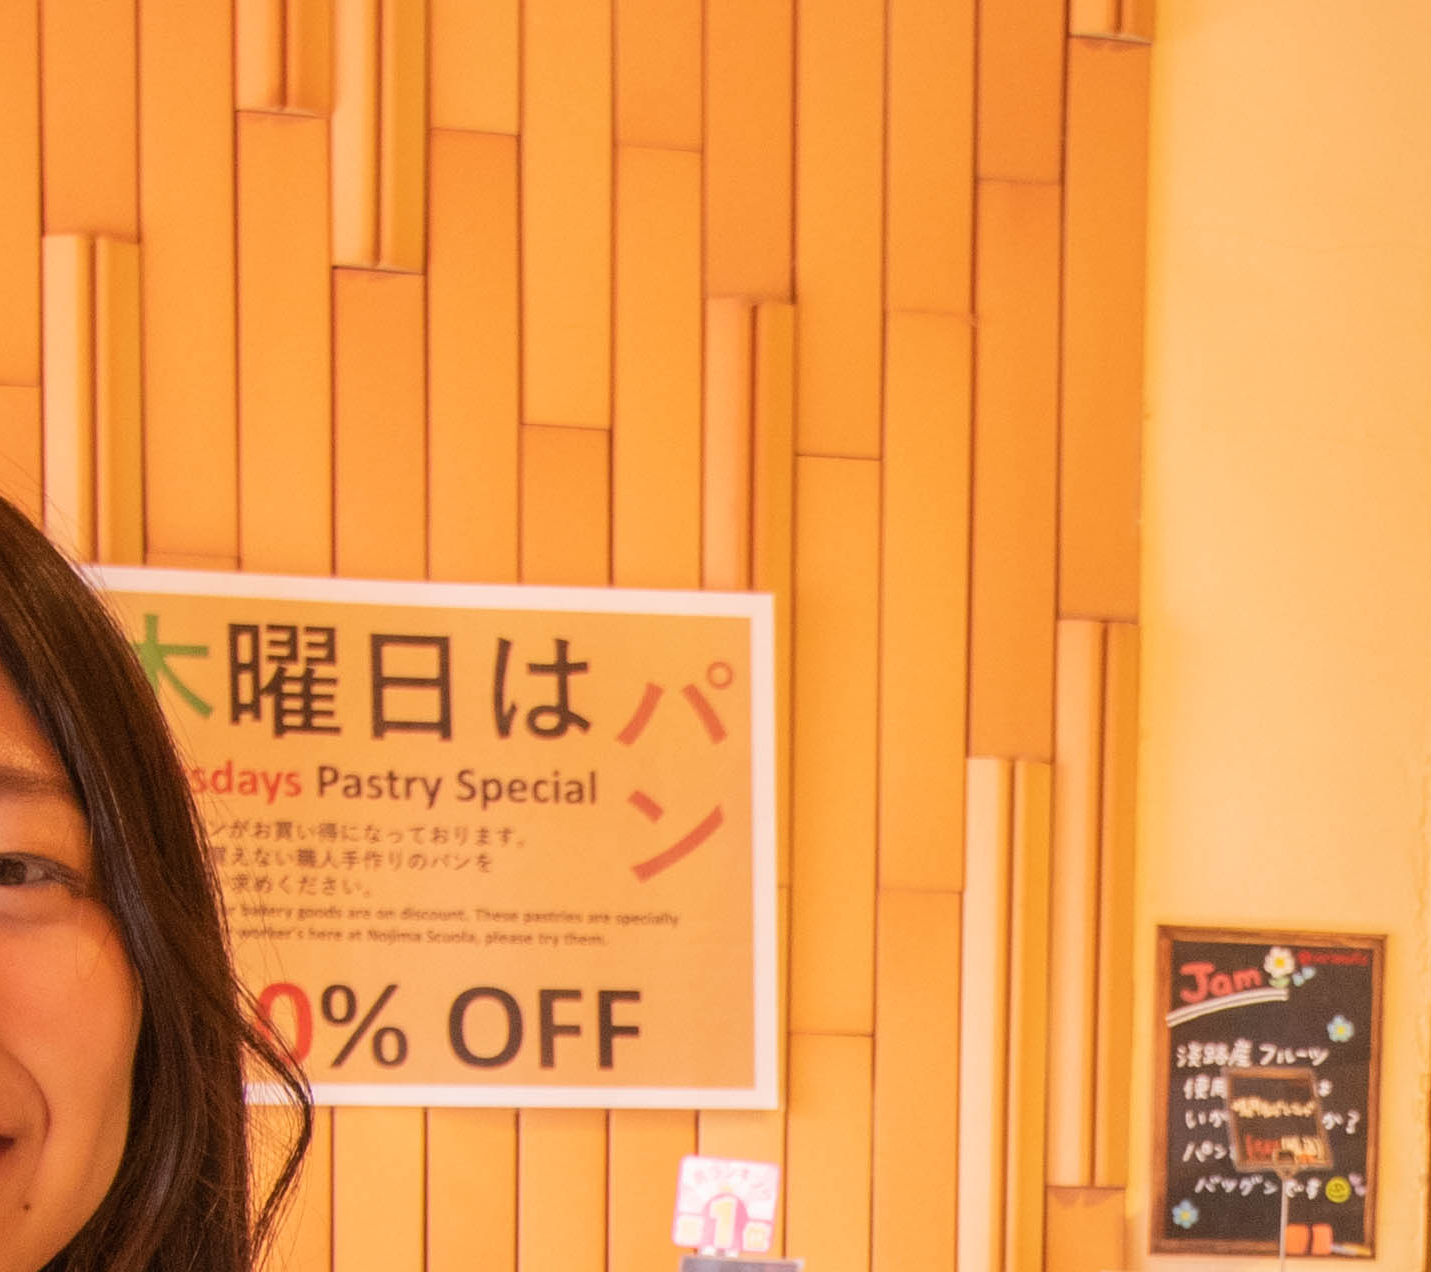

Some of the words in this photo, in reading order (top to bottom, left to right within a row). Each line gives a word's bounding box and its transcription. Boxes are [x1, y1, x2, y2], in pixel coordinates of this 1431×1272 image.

[183, 760, 302, 805] sdays
[316, 763, 443, 810] Pastry
[455, 767, 598, 810] Special
[615, 661, 735, 884] パン
[209, 819, 527, 850] ンがお買い得になっております。
[229, 873, 372, 899] 求めください。
[1179, 961, 1263, 1003] Jam
[257, 981, 410, 1070] 0%
[448, 985, 643, 1072] OFF
